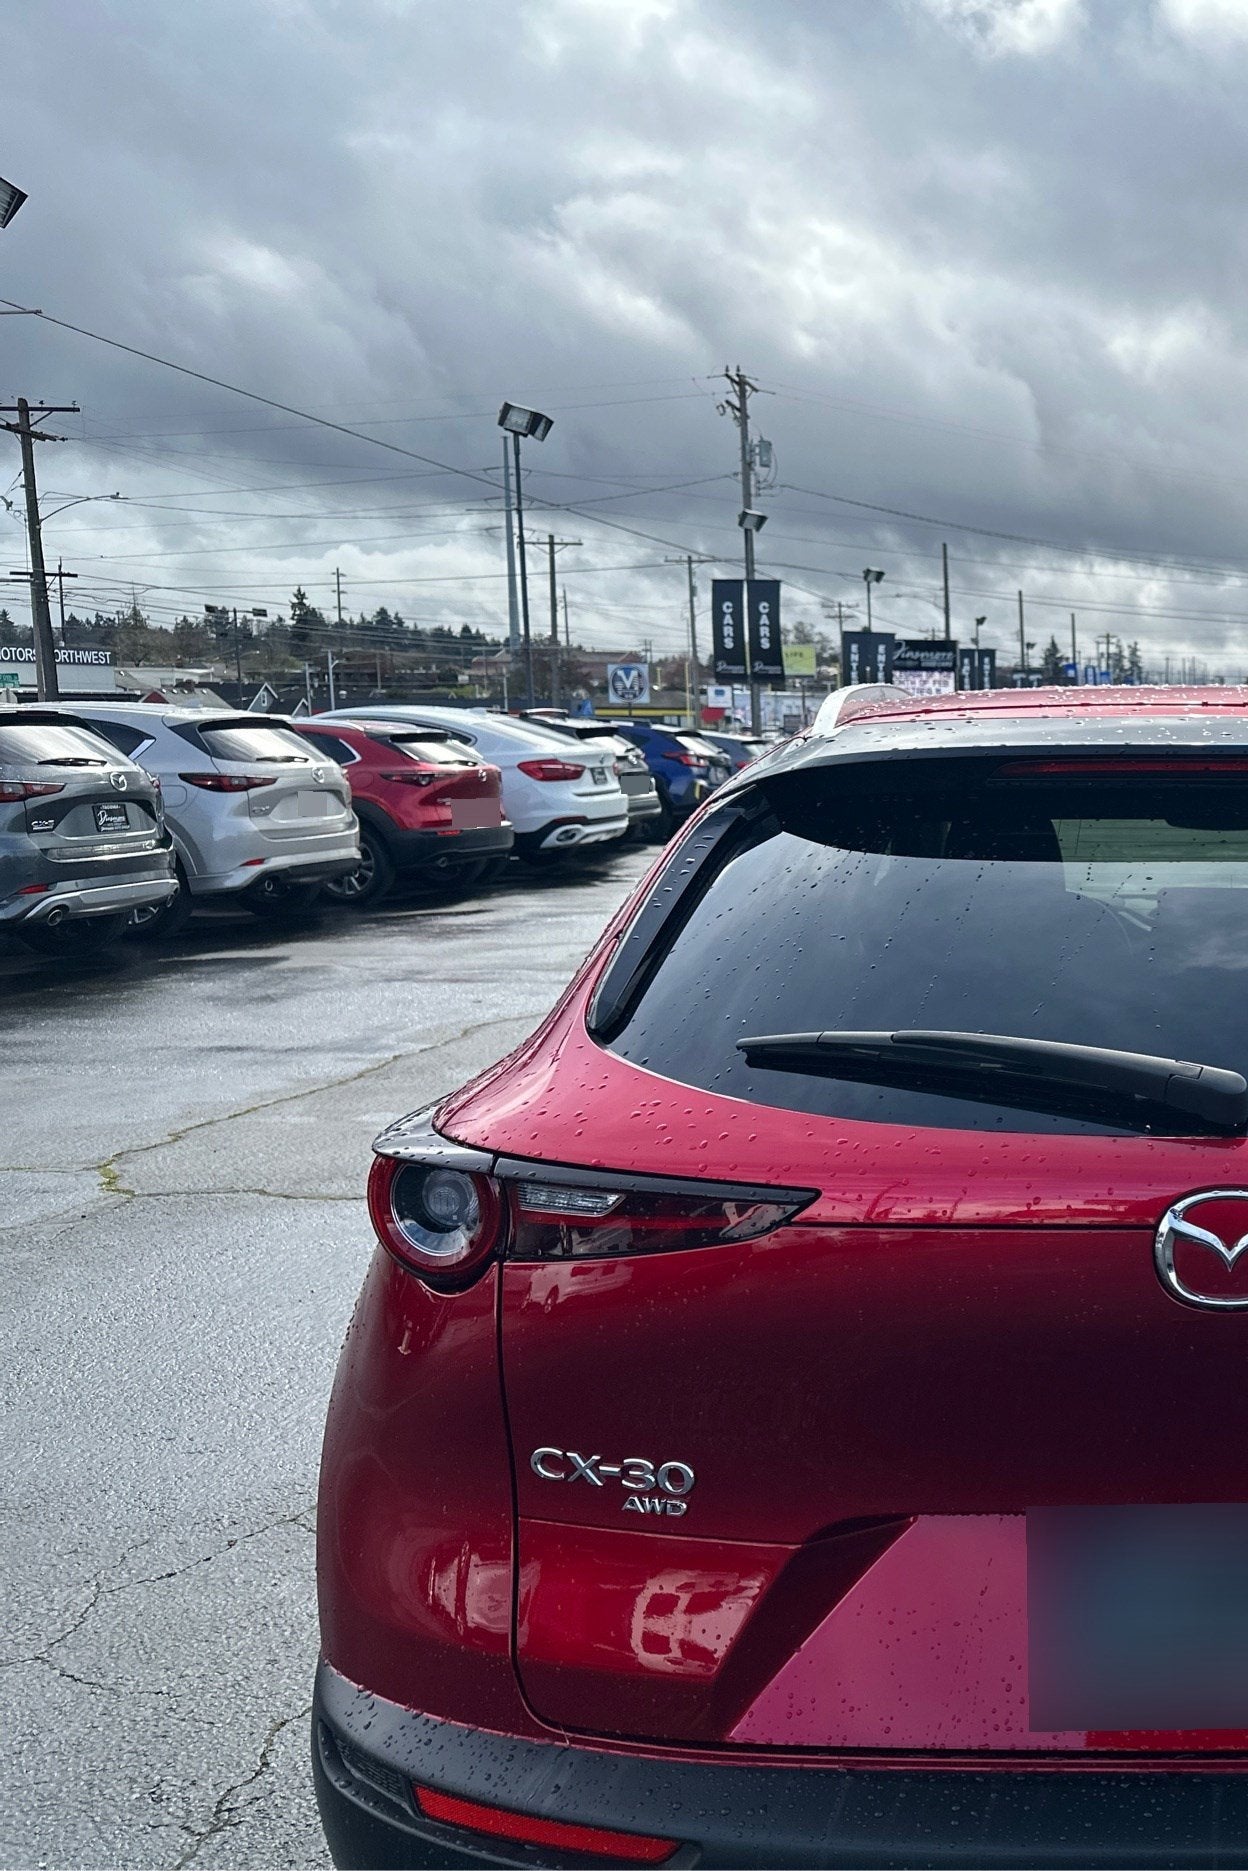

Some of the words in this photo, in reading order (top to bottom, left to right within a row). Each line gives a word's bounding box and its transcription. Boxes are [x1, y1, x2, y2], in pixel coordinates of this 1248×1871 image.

[722, 601, 734, 649] CARS
[759, 601, 770, 649] CARS
[0, 647, 36, 661] OTORS
[54, 649, 111, 664] ORTHWEST
[877, 644, 886, 683] ENTE
[530, 1447, 695, 1495] CX-30
[621, 1496, 687, 1517] AWD
